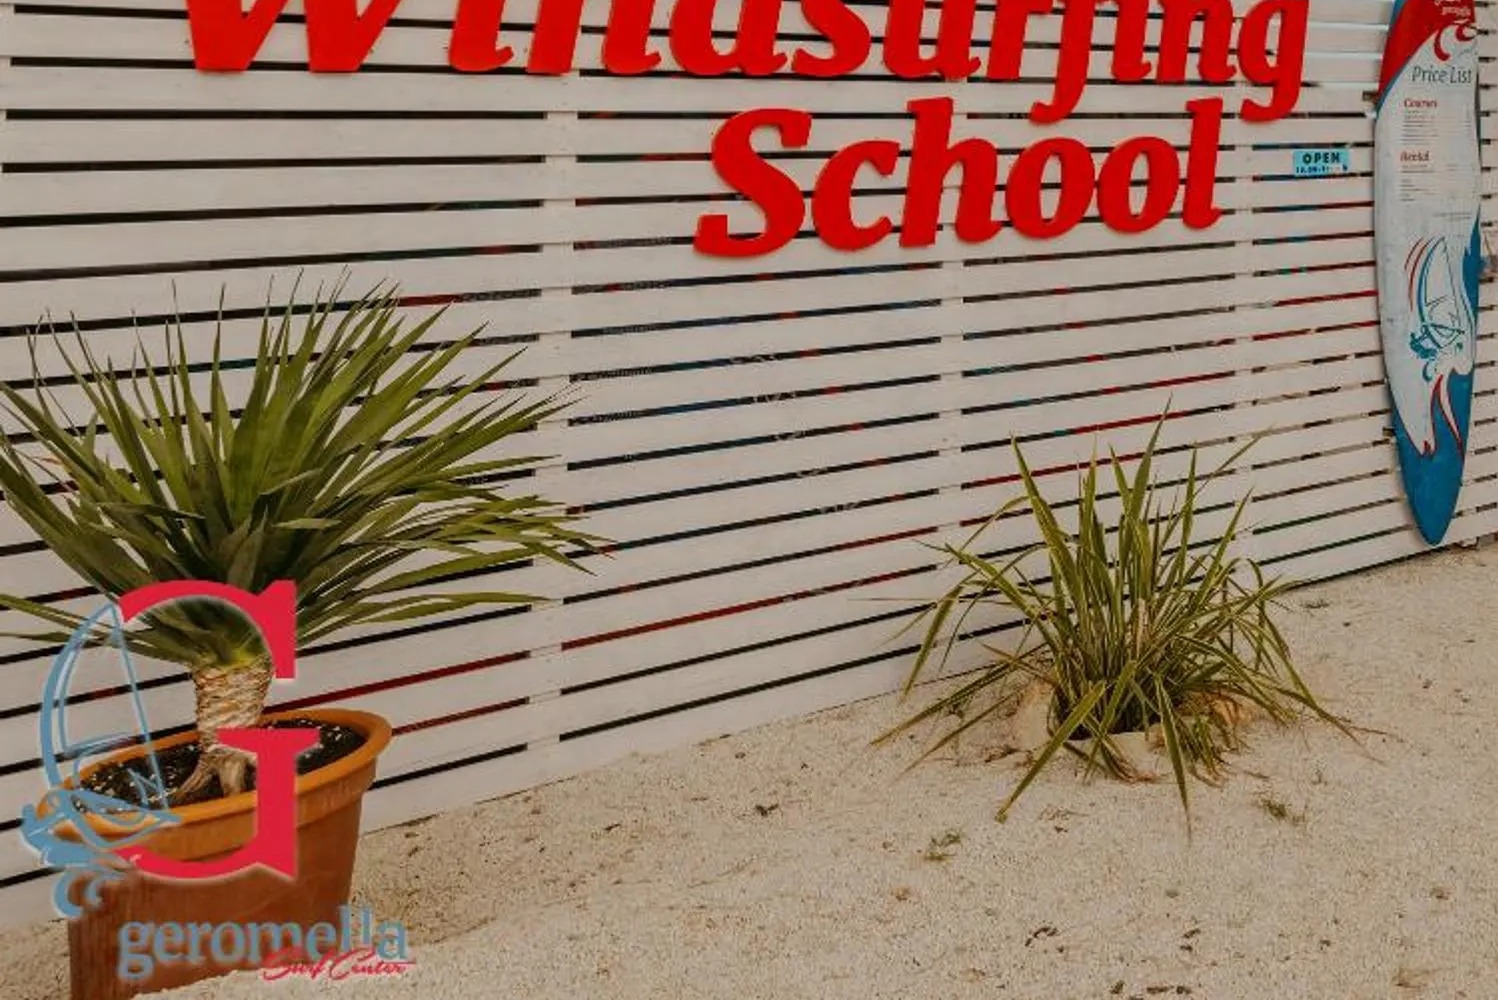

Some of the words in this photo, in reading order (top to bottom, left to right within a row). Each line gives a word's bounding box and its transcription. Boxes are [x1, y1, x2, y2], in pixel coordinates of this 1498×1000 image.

[1411, 64, 1447, 83] Price
[1450, 66, 1472, 84] List
[1302, 152, 1340, 165] OPEN
[694, 95, 1225, 257] School
